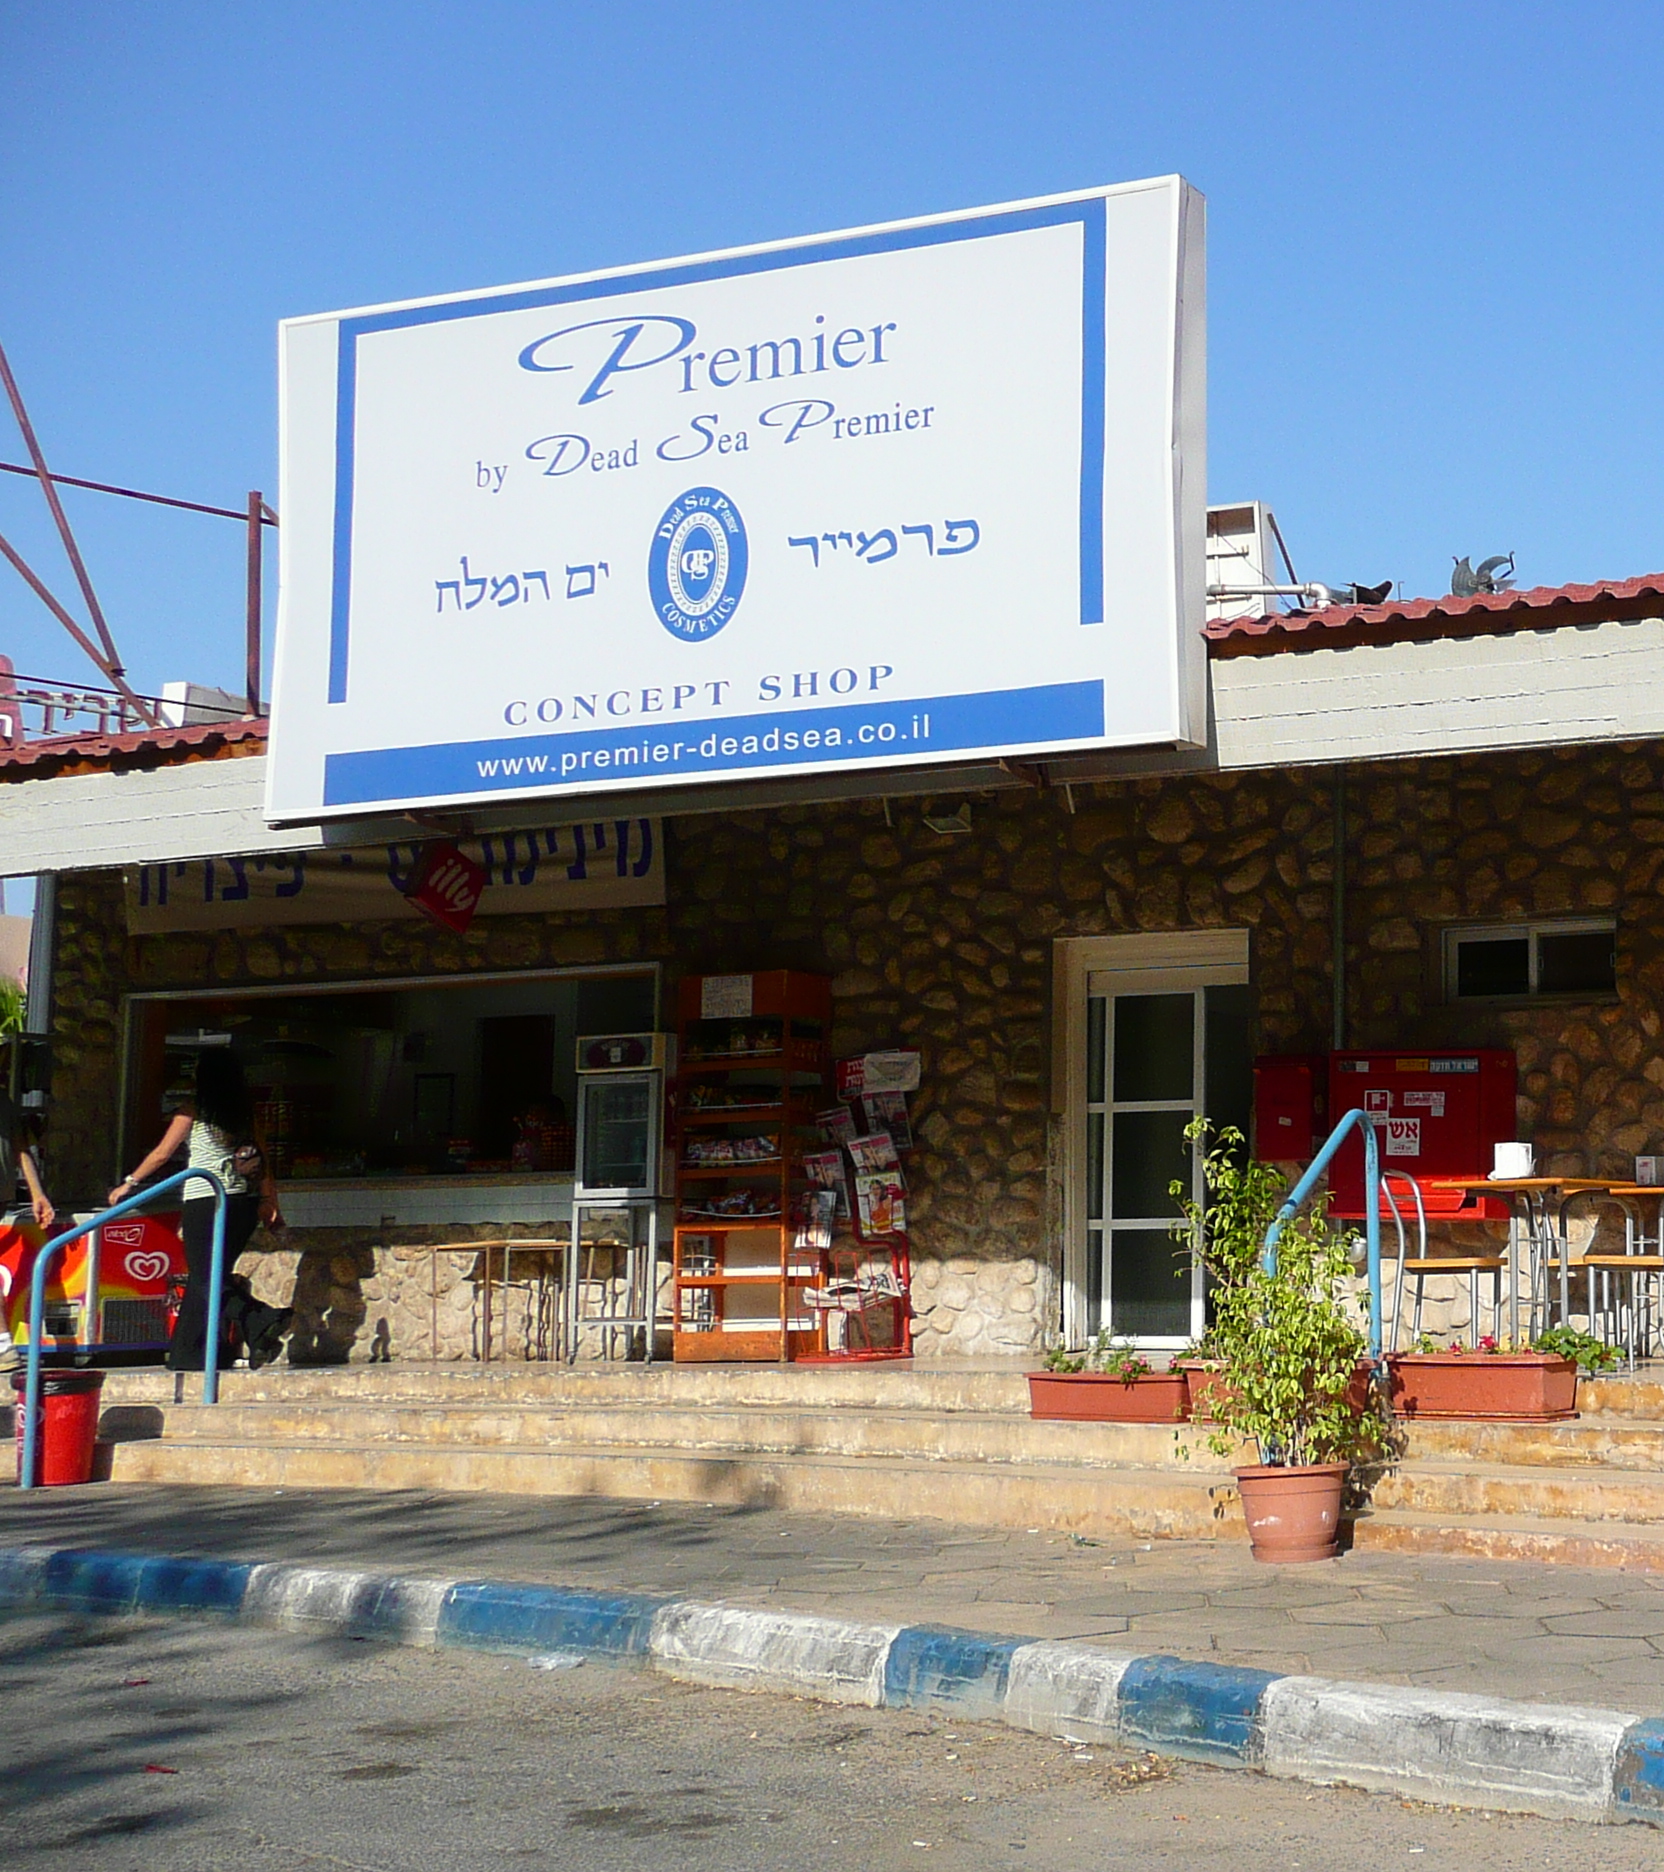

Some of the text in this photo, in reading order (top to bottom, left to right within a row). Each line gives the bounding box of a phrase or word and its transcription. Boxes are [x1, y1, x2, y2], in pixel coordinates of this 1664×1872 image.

[518, 314, 897, 406] Premier
[476, 399, 935, 494] by Dead Sea Premier
[435, 518, 981, 614] פרמייר ים המלח
[662, 595, 736, 633] COSMETICS
[503, 664, 894, 727] CONCEPT SHOP
[477, 713, 931, 779] www.premier-deadsea.co.il
[428, 857, 476, 913] illy
[1389, 1120, 1418, 1139] אש
